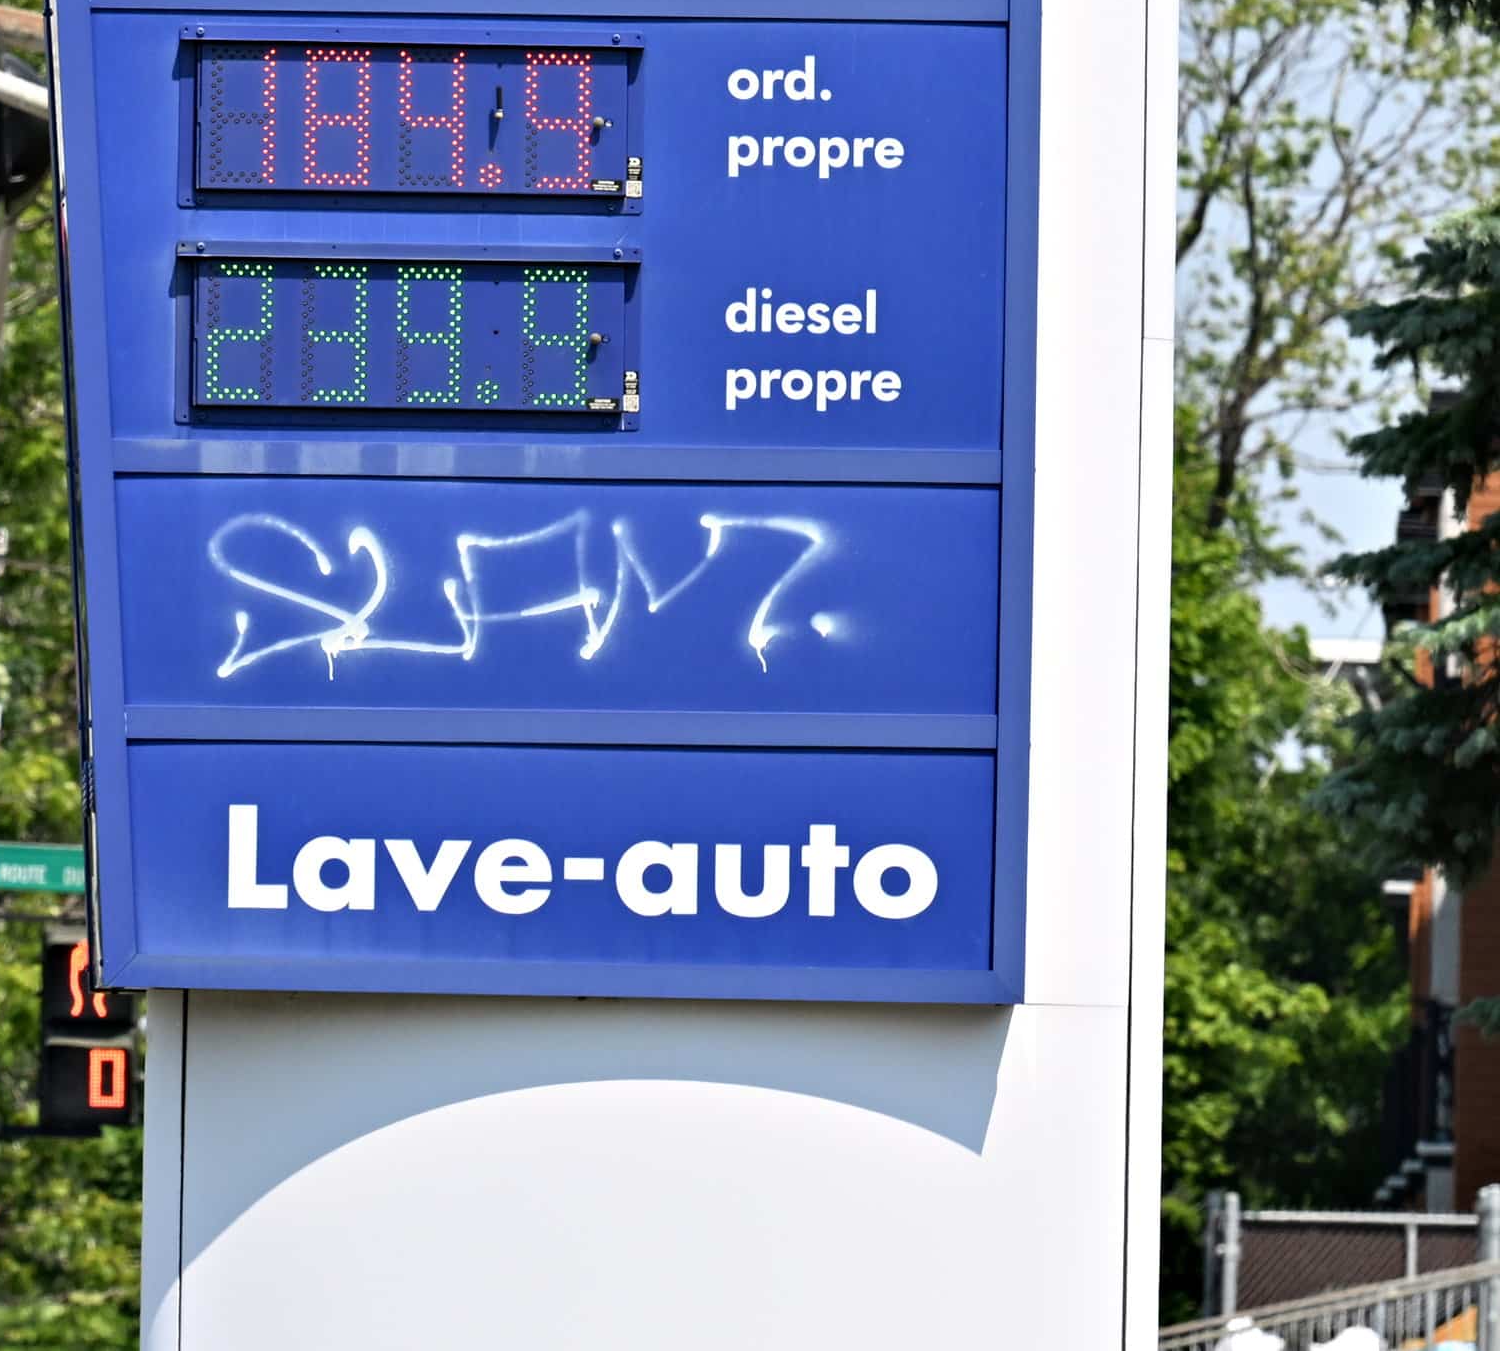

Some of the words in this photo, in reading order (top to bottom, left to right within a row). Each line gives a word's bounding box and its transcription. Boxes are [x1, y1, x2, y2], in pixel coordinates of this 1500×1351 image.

[727, 55, 832, 101] ord.
[261, 48, 592, 190] 184.9
[728, 135, 905, 179] propre
[725, 287, 878, 335] diesel
[725, 368, 902, 412] propre
[0, 863, 47, 885] ROUTE
[227, 804, 938, 920] Lave-auto
